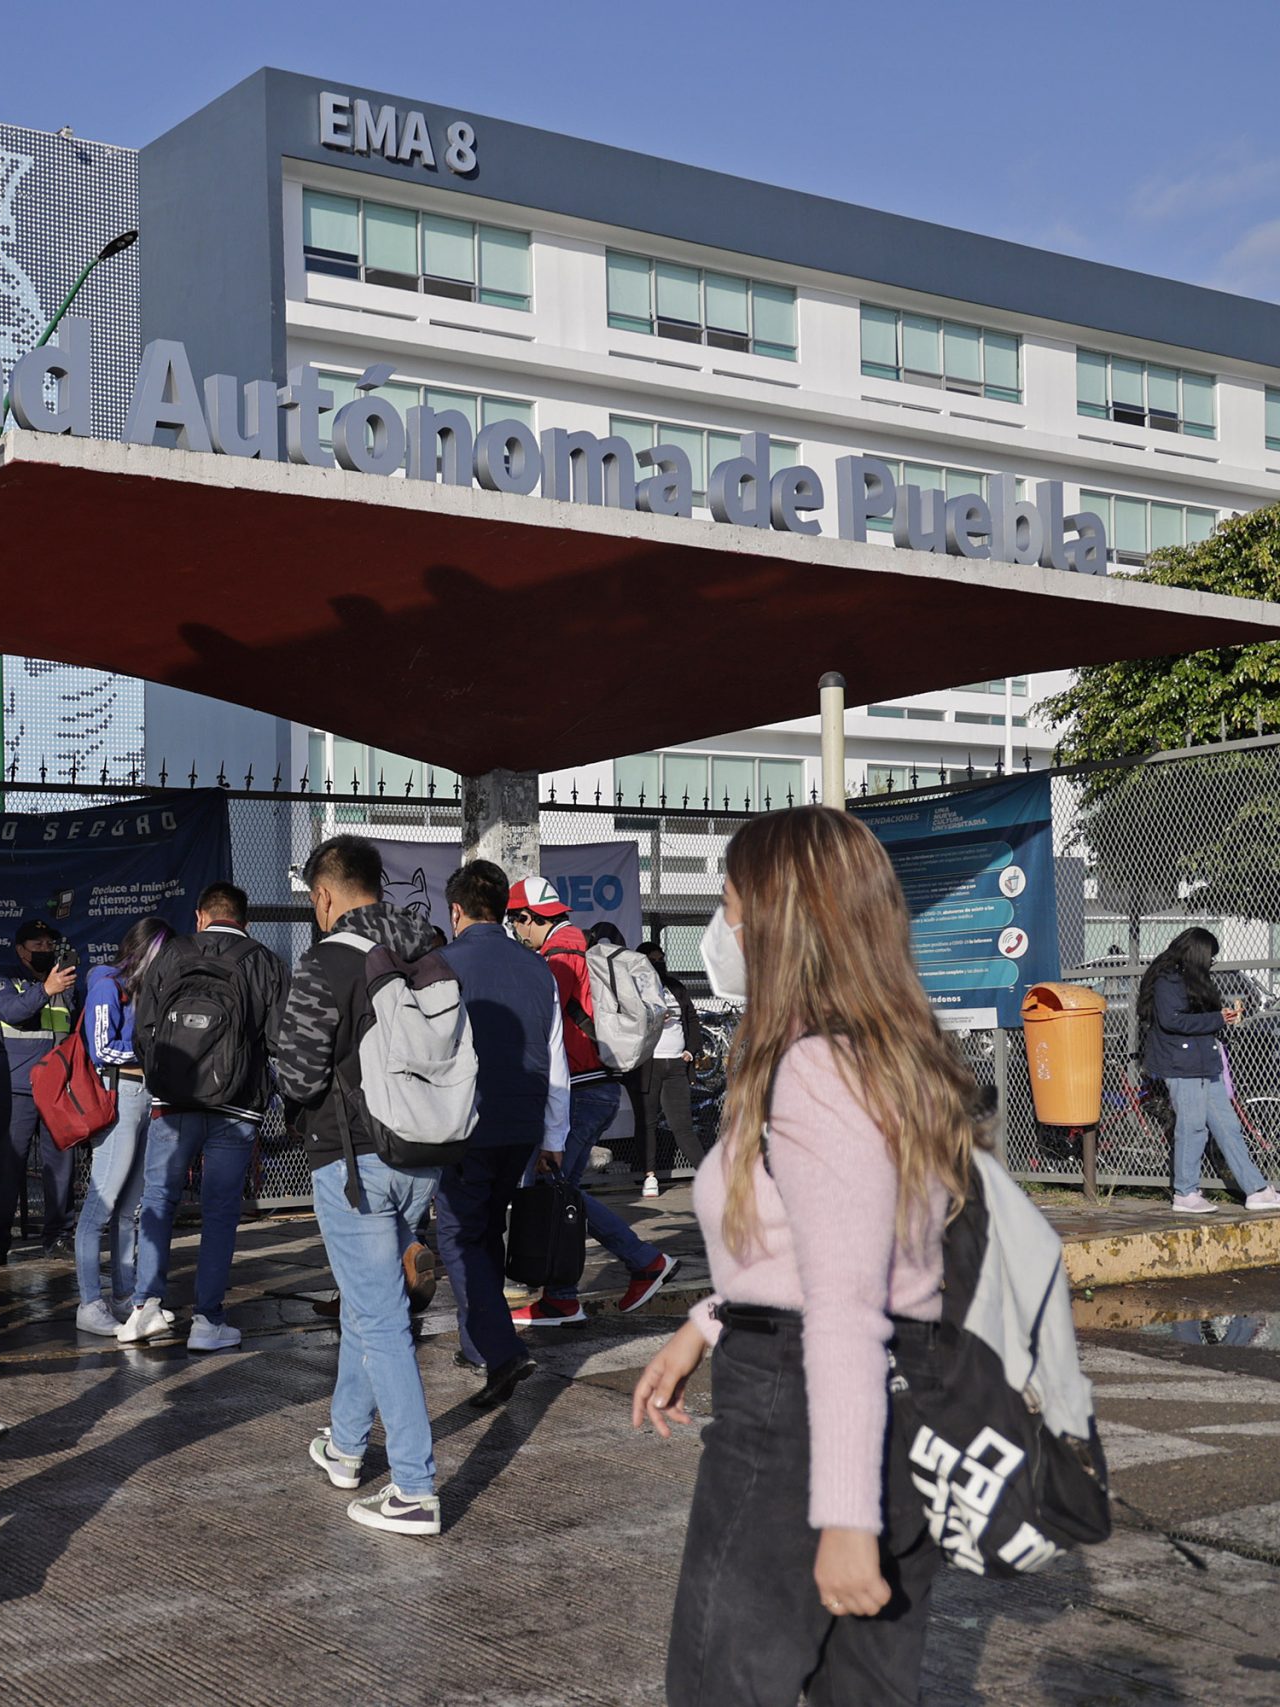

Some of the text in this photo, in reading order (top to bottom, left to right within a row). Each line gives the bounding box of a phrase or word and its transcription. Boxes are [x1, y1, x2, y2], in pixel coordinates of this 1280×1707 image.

[320, 91, 477, 173] EMA 8
[121, 338, 693, 519] Autónoma
[708, 431, 825, 536] de
[835, 454, 1108, 577] Puebla
[43, 810, 179, 842] SEGURO
[91, 884, 128, 896] Reduce
[129, 882, 140, 893] al
[99, 895, 138, 906] tiempo
[88, 903, 158, 917] en interiores
[87, 942, 119, 953] Evita
